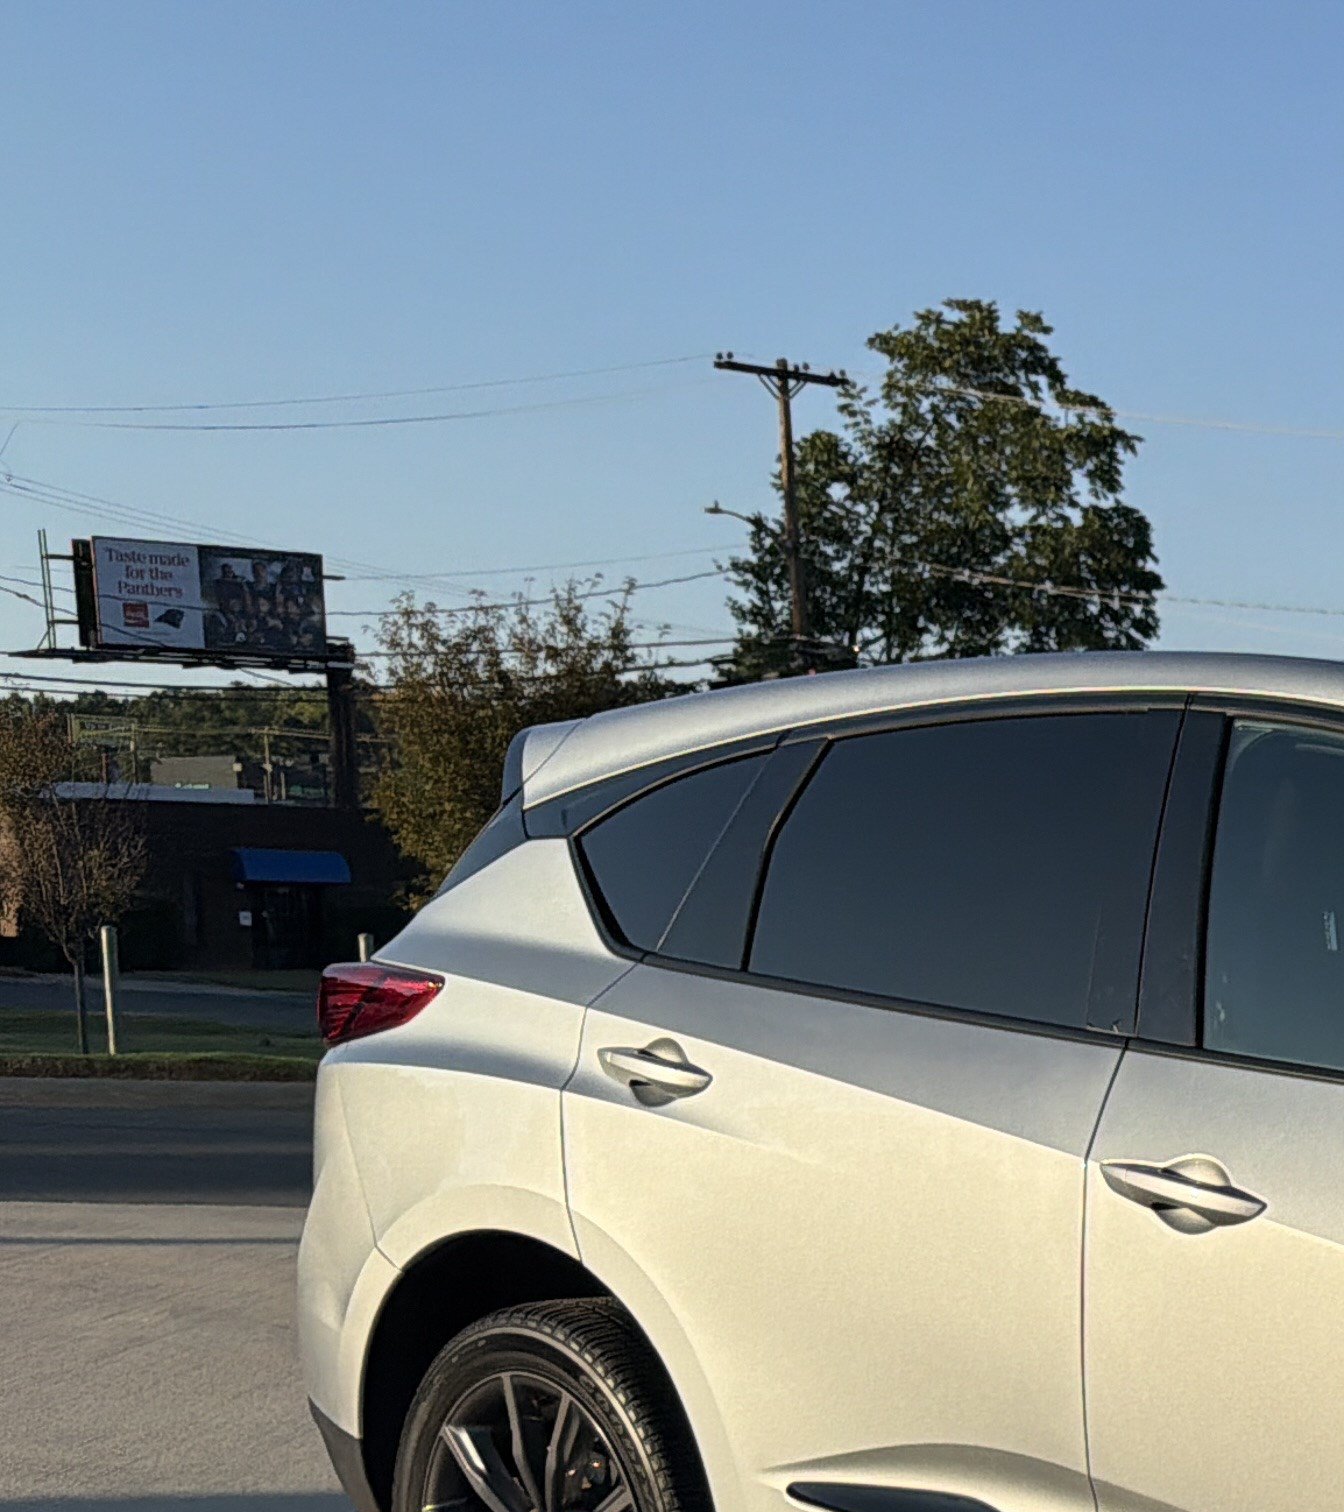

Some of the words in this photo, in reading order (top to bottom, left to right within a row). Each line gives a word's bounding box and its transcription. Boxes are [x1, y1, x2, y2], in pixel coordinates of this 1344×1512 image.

[104, 546, 146, 564] Taste
[149, 552, 190, 567] made
[125, 566, 144, 579] for
[149, 567, 173, 581] the
[118, 581, 183, 598] Panthers
